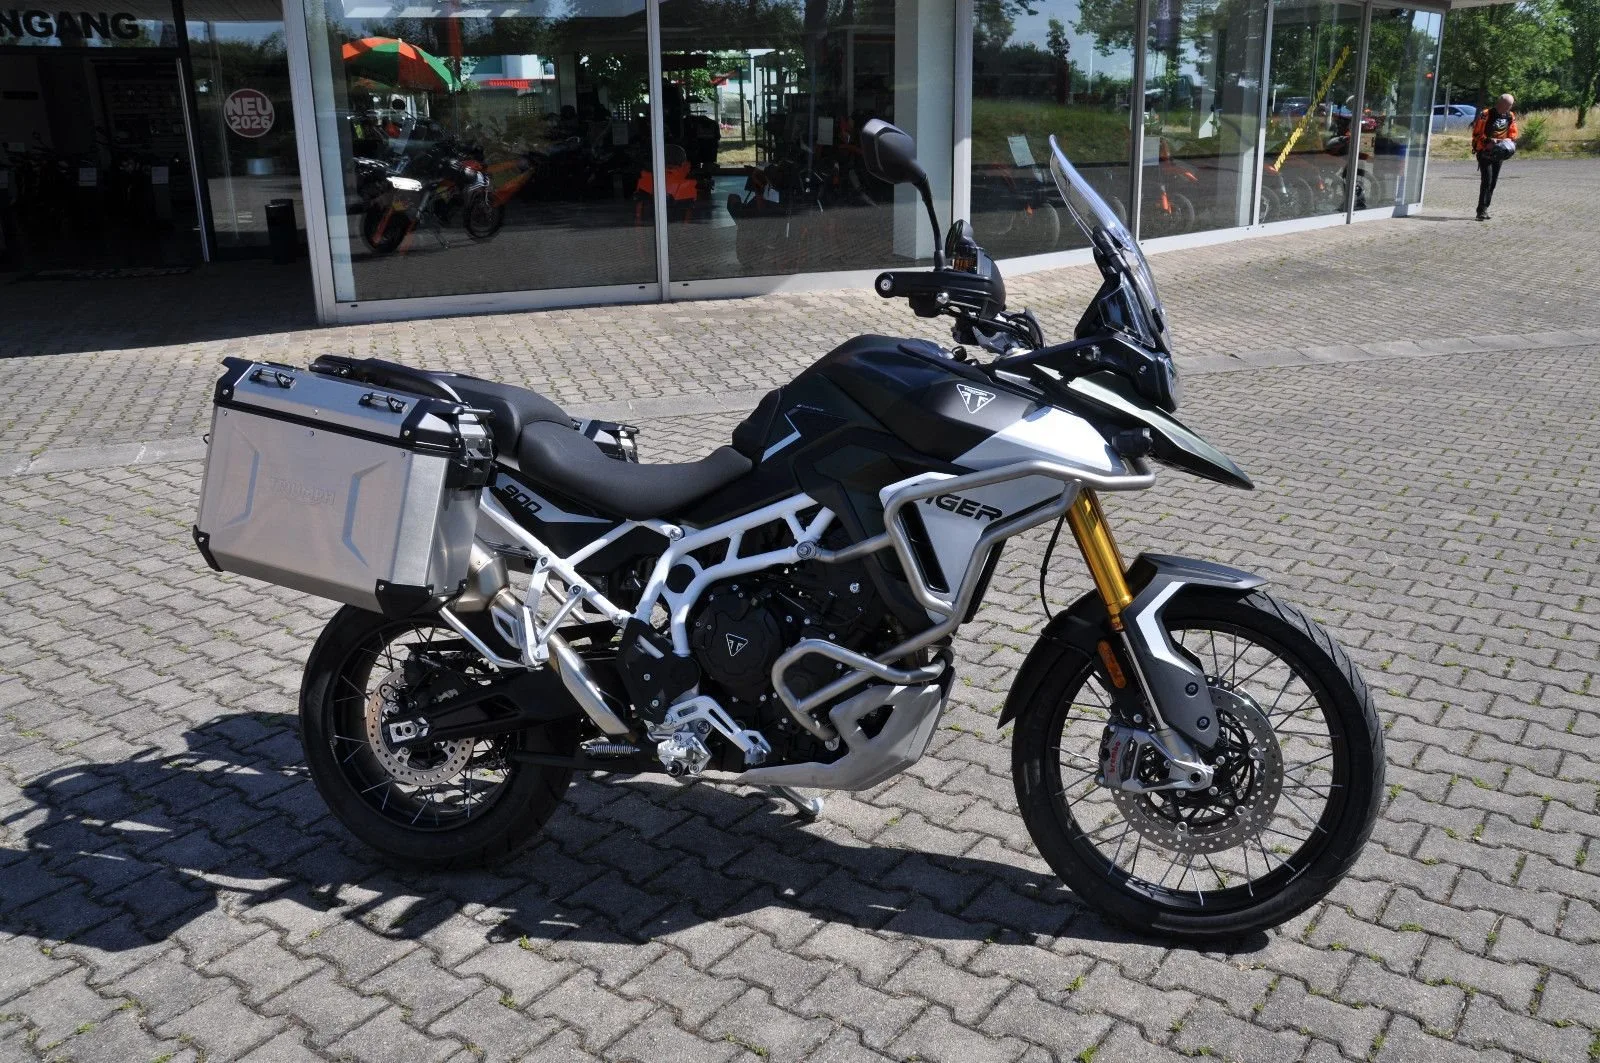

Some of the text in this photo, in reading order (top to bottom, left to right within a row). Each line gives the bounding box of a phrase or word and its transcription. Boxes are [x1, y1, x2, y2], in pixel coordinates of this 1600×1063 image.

[226, 96, 272, 116] NEU
[230, 115, 271, 130] 2026
[503, 484, 543, 513] 900
